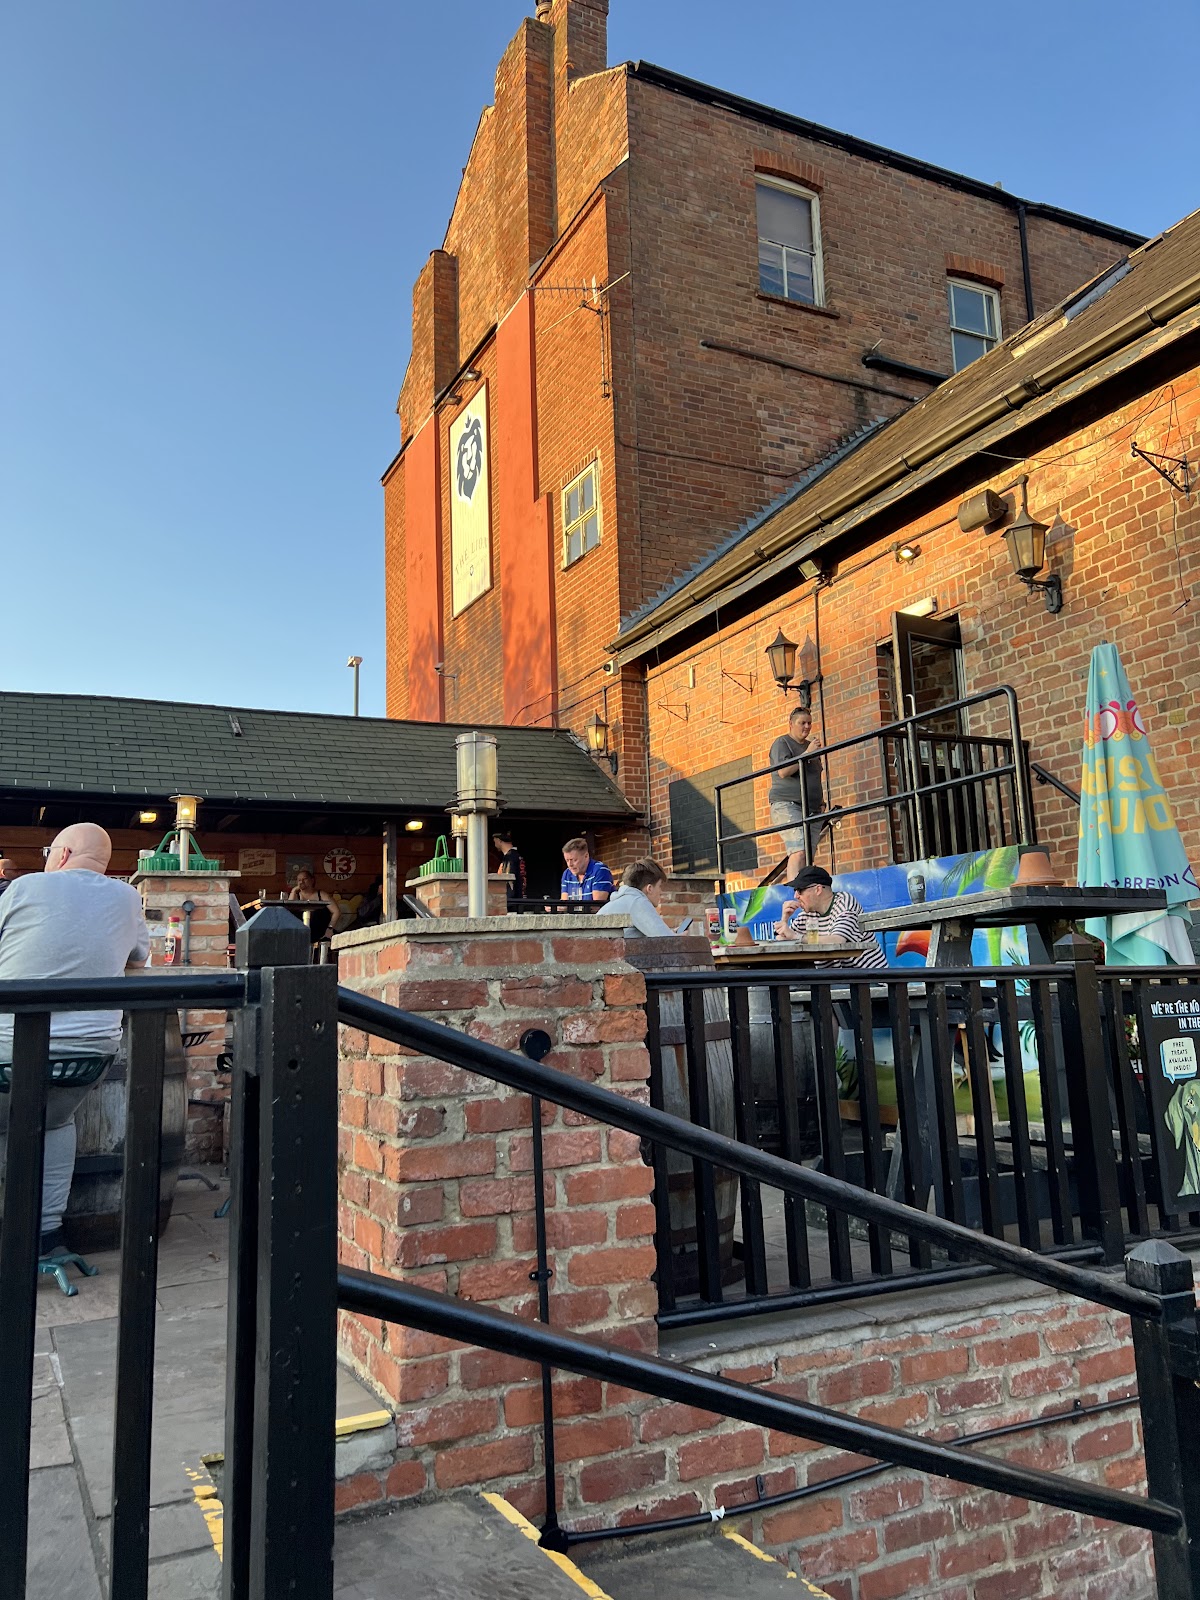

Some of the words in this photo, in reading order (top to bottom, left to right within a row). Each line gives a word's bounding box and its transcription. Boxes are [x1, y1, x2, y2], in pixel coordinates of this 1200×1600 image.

[455, 548, 469, 575] THE
[331, 856, 352, 873] 13
[1151, 1001, 1174, 1015] WE'RE
[1174, 999, 1189, 1014] THE
[1178, 1017, 1187, 1029] IN
[1187, 1016, 1200, 1029] THE
